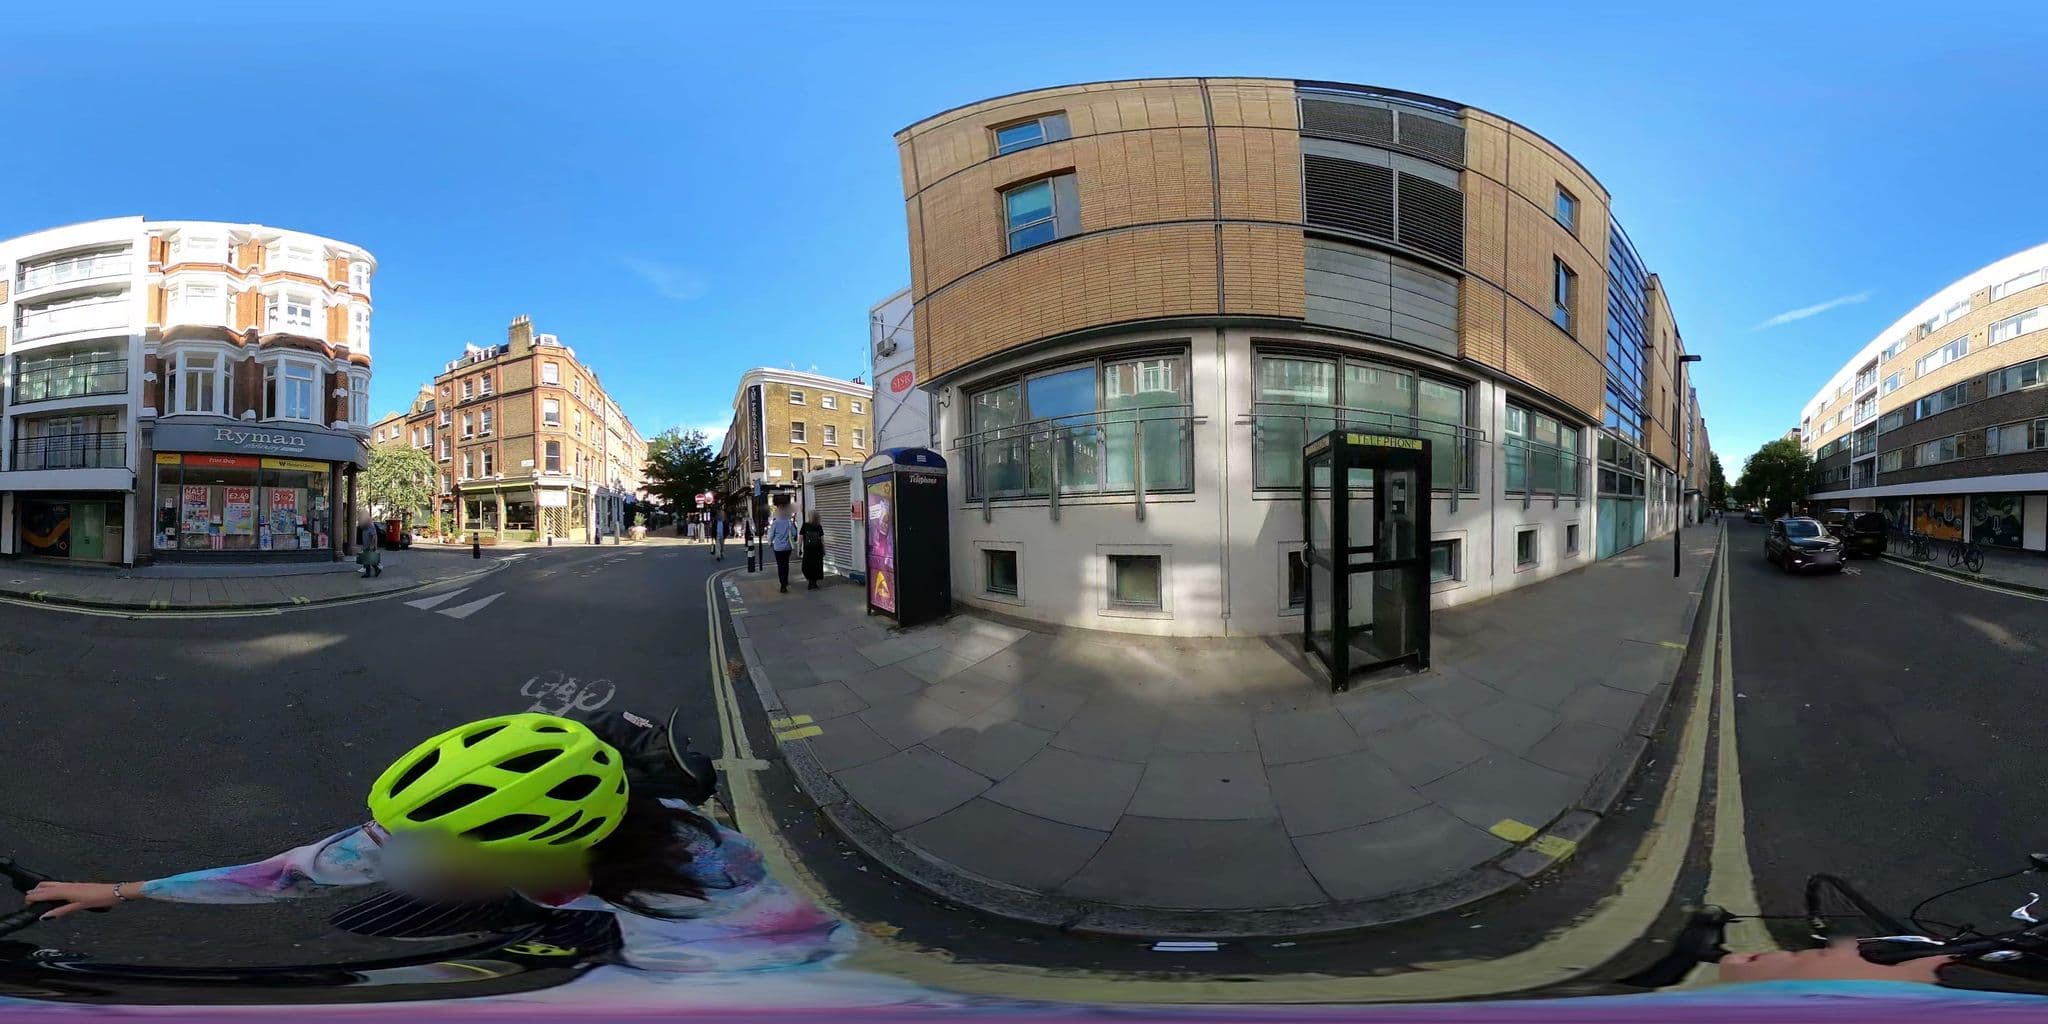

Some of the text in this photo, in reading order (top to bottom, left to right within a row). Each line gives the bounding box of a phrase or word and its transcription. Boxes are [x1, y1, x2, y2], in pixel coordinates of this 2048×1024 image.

[215, 428, 306, 446] Ryman
[1357, 435, 1418, 448] TELEPHONE
[186, 488, 205, 496] HALF
[229, 492, 249, 501] £2.49
[274, 493, 281, 502] 3
[288, 493, 295, 502] 2
